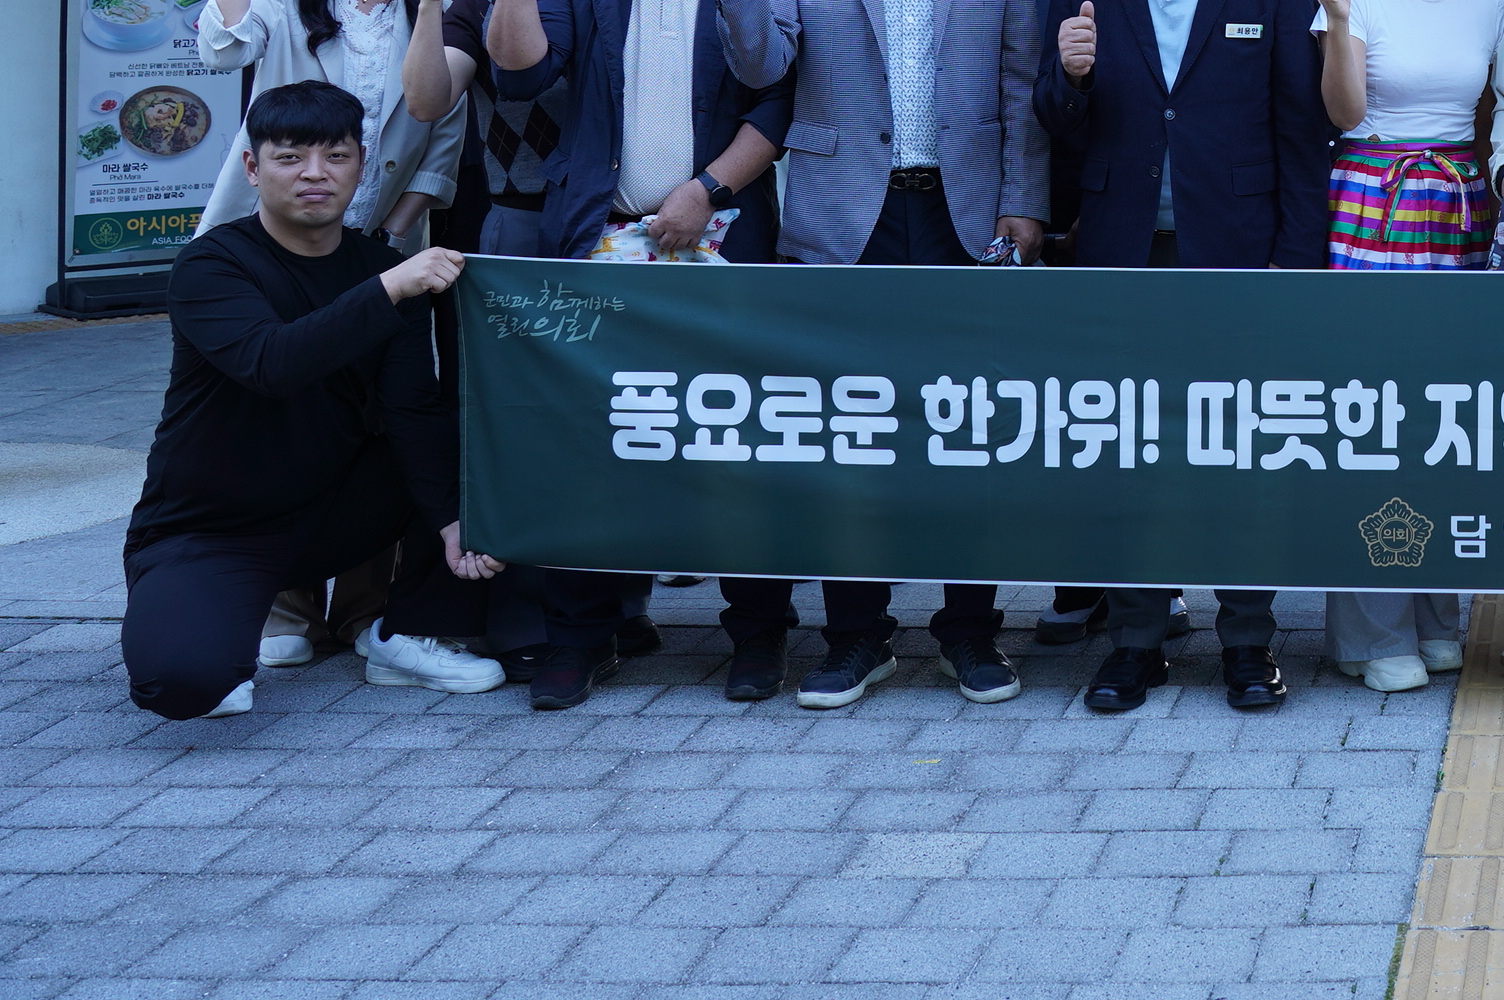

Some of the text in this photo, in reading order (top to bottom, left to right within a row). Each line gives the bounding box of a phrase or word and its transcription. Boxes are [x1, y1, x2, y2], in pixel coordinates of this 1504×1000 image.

[102, 162, 149, 173] 마라 쌀국수
[163, 191, 185, 199] 쌀국수
[152, 236, 172, 245] ASIA
[483, 279, 626, 311] 군민과 함께하는
[609, 371, 899, 465] 풍요로운
[920, 375, 1160, 469] 한가위!
[1187, 378, 1406, 471] 따뜻한
[1383, 528, 1409, 543] 의회
